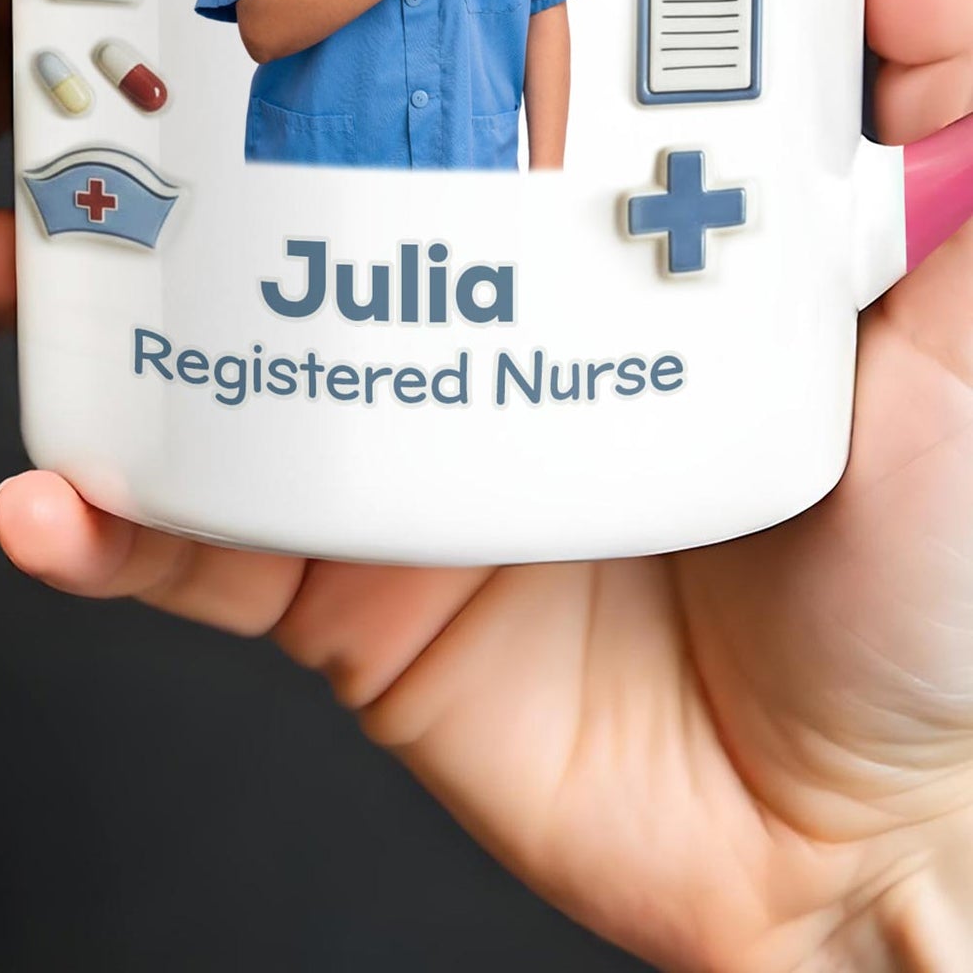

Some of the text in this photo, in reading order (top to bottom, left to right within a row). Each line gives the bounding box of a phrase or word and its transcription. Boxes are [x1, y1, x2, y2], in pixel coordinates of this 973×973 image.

[261, 240, 514, 324] Julia
[134, 328, 683, 406] Registered Nurse
